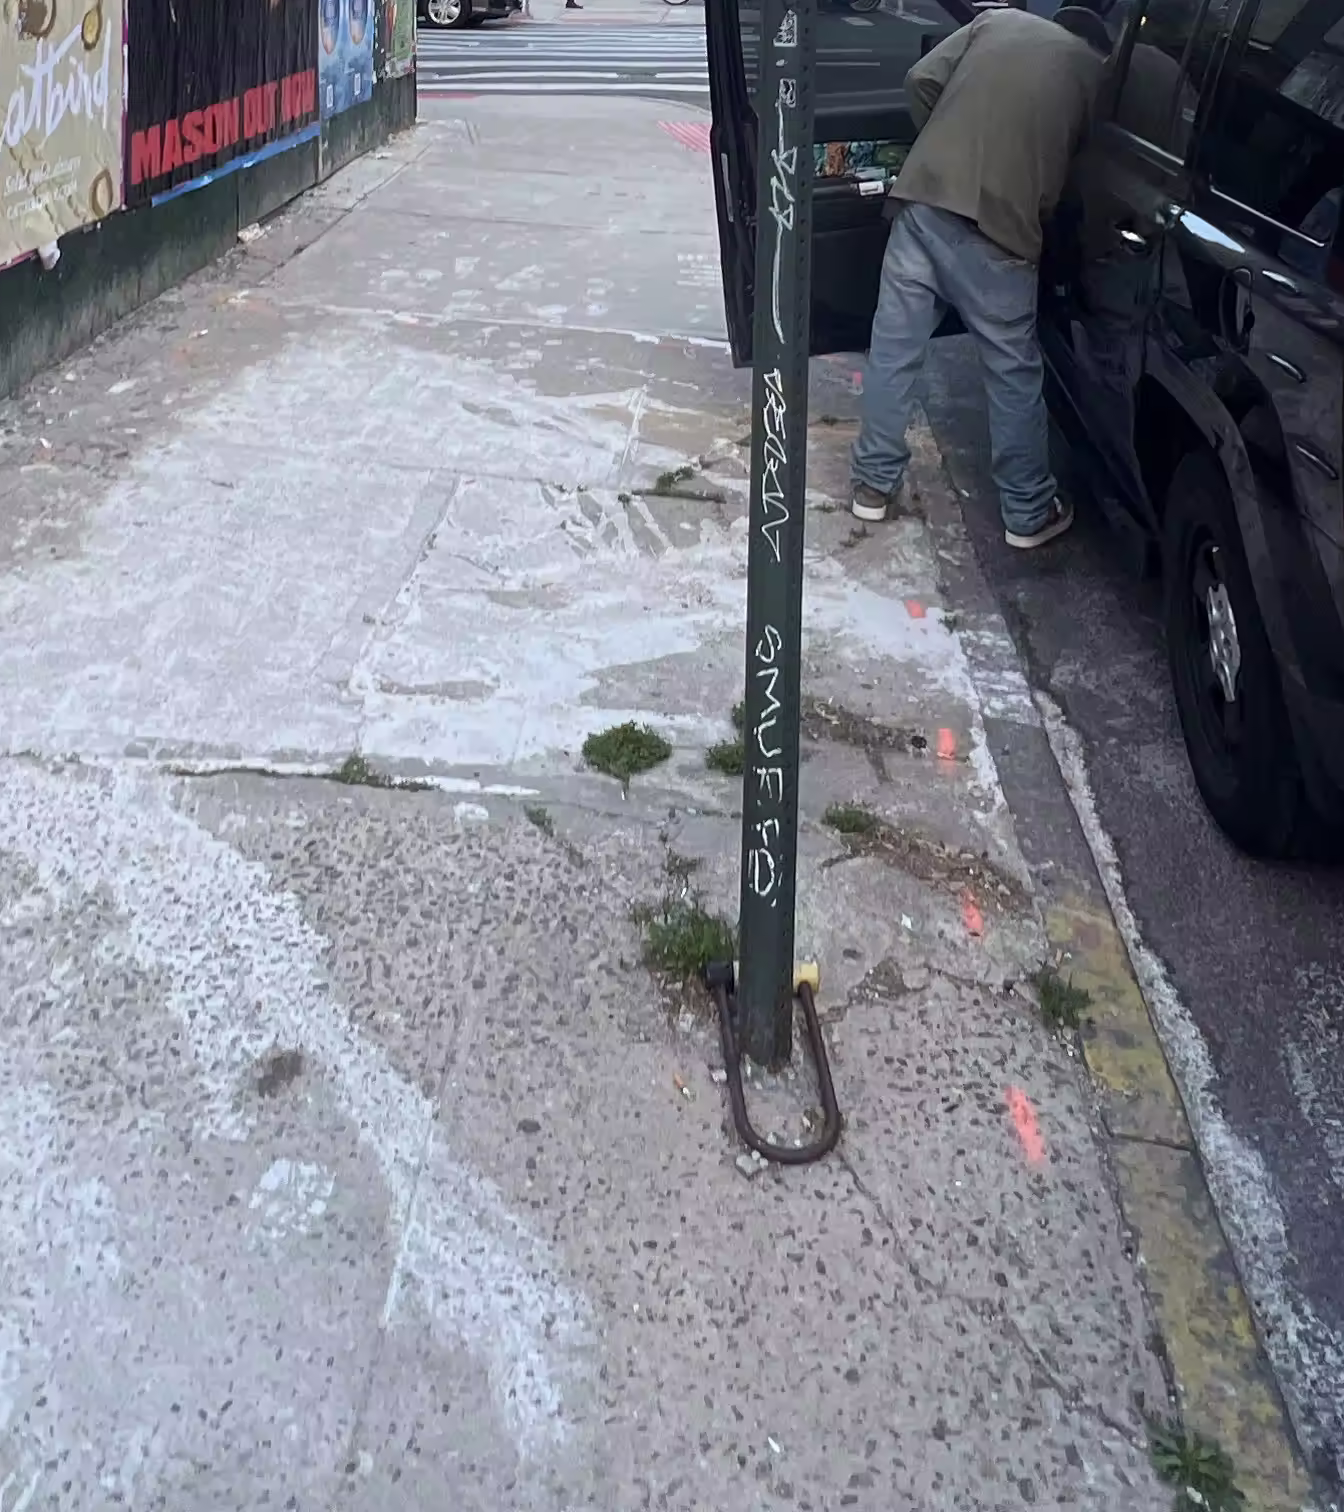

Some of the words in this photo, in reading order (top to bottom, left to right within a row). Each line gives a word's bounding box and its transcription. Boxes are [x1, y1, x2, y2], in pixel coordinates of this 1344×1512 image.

[132, 97, 240, 185] MASON
[244, 81, 279, 139] OUT
[281, 68, 316, 122] NOW
